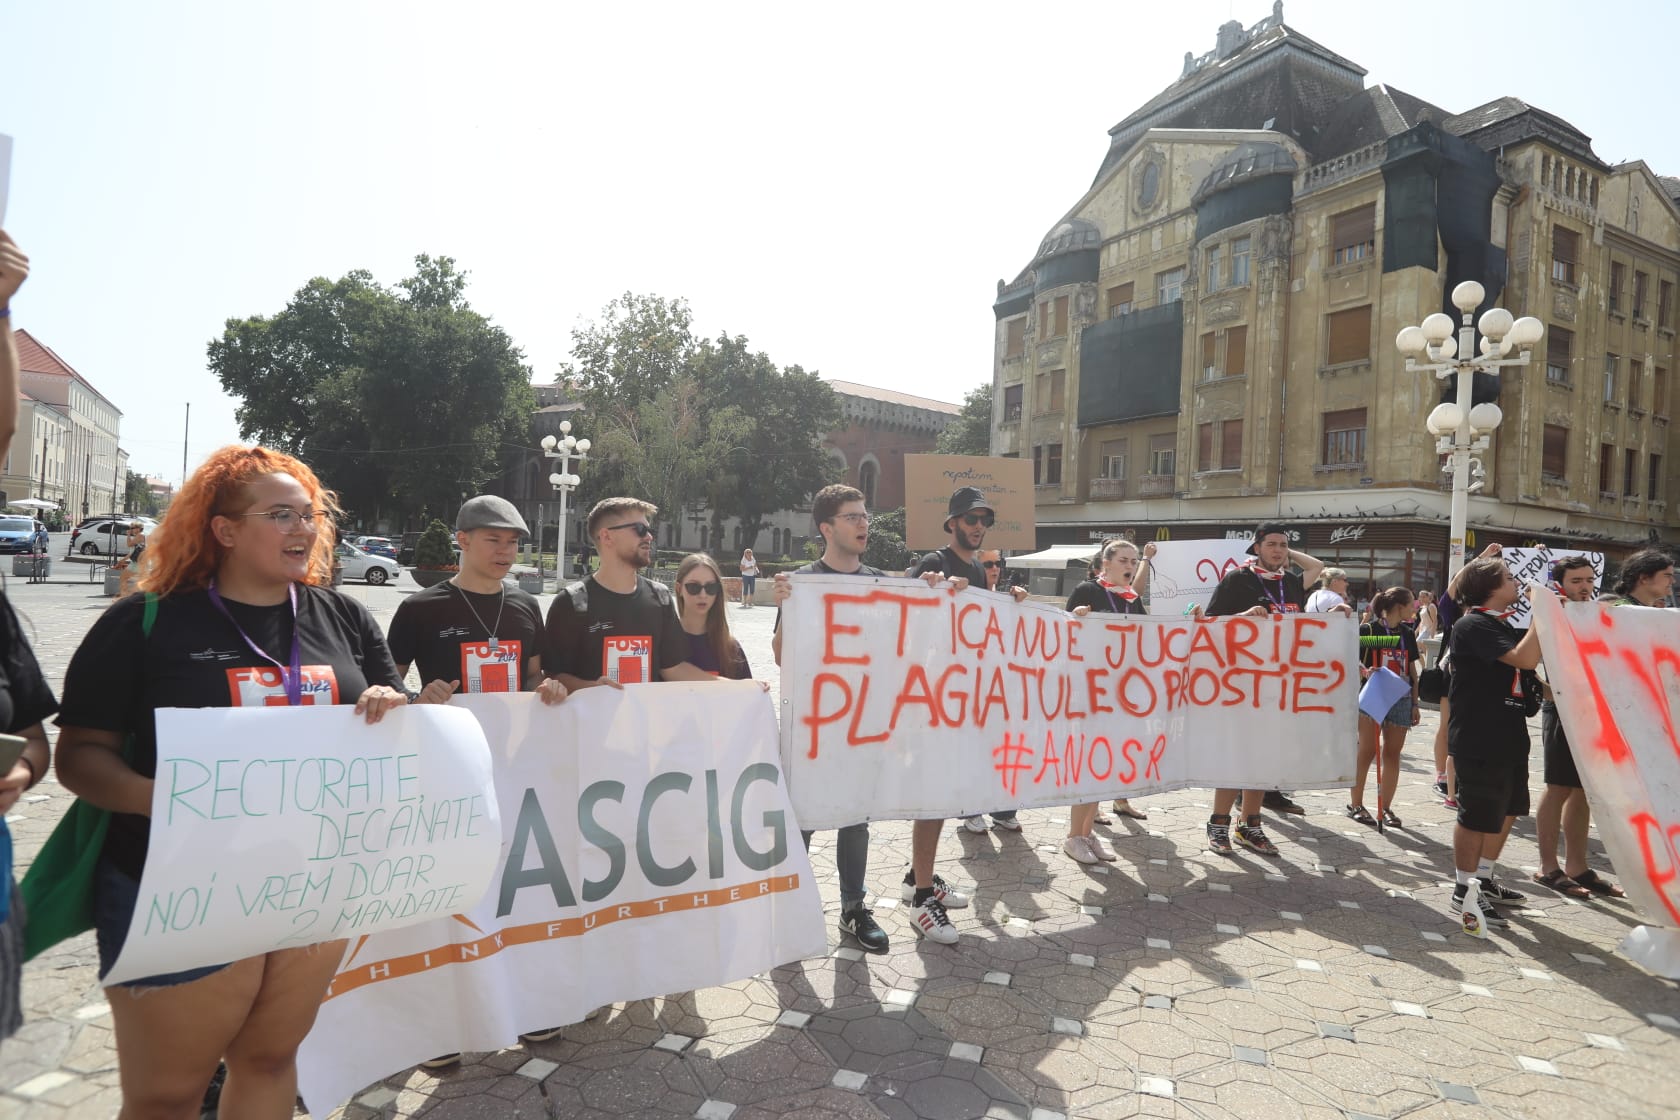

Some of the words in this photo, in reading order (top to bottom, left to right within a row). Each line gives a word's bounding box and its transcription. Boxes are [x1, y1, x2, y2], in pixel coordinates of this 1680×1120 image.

[165, 754, 425, 825] RECTORATE,
[992, 730, 1167, 797] #ANOSR
[308, 795, 483, 860] DECANATE
[496, 762, 788, 918] ASCIG
[236, 867, 335, 916] VREM
[344, 854, 435, 900] DOAR
[276, 909, 319, 945] 2
[331, 883, 469, 933] MANDATE
